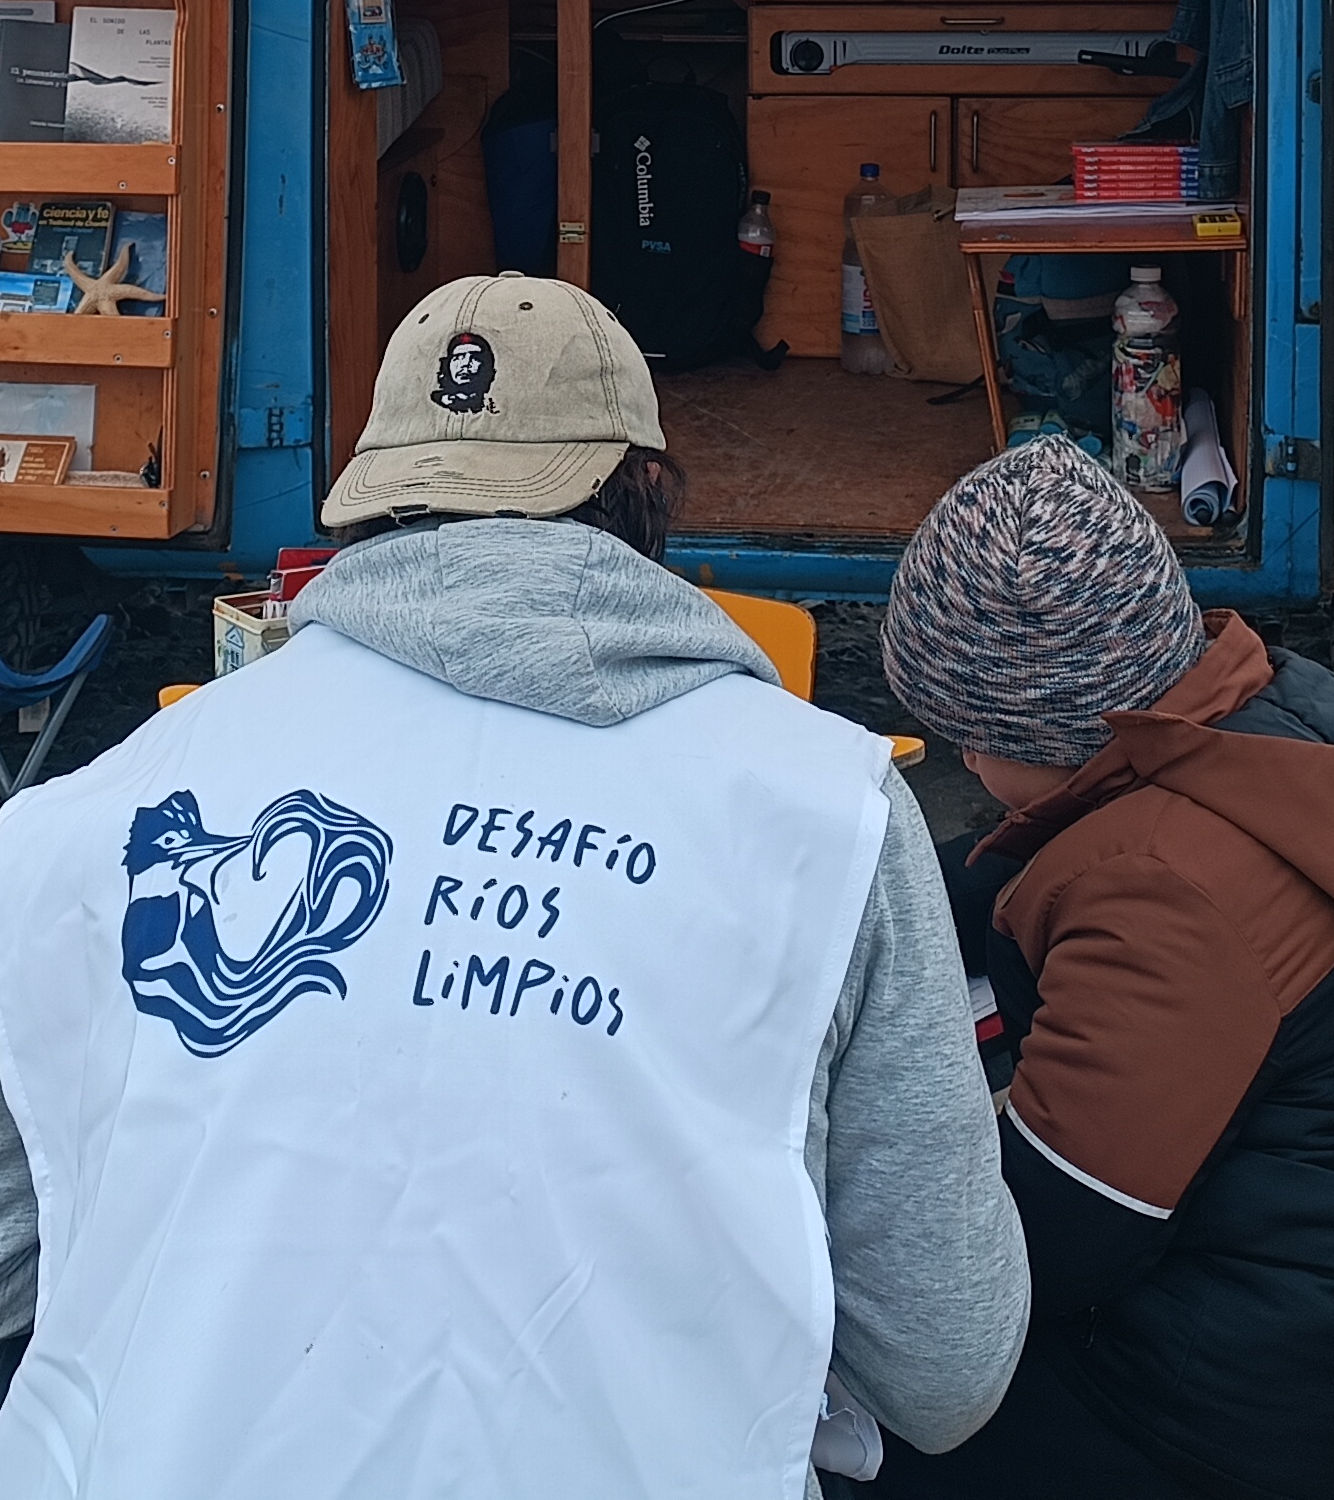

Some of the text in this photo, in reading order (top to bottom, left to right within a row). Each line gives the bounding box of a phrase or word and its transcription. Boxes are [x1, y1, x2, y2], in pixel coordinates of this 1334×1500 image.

[102, 17, 126, 25] SONIDO
[635, 151, 655, 227] Columbia
[42, 206, 109, 221] ciencia y fe
[641, 239, 672, 252] PVSA
[443, 803, 657, 885] DESAFÍO
[423, 875, 562, 938] RÍOS
